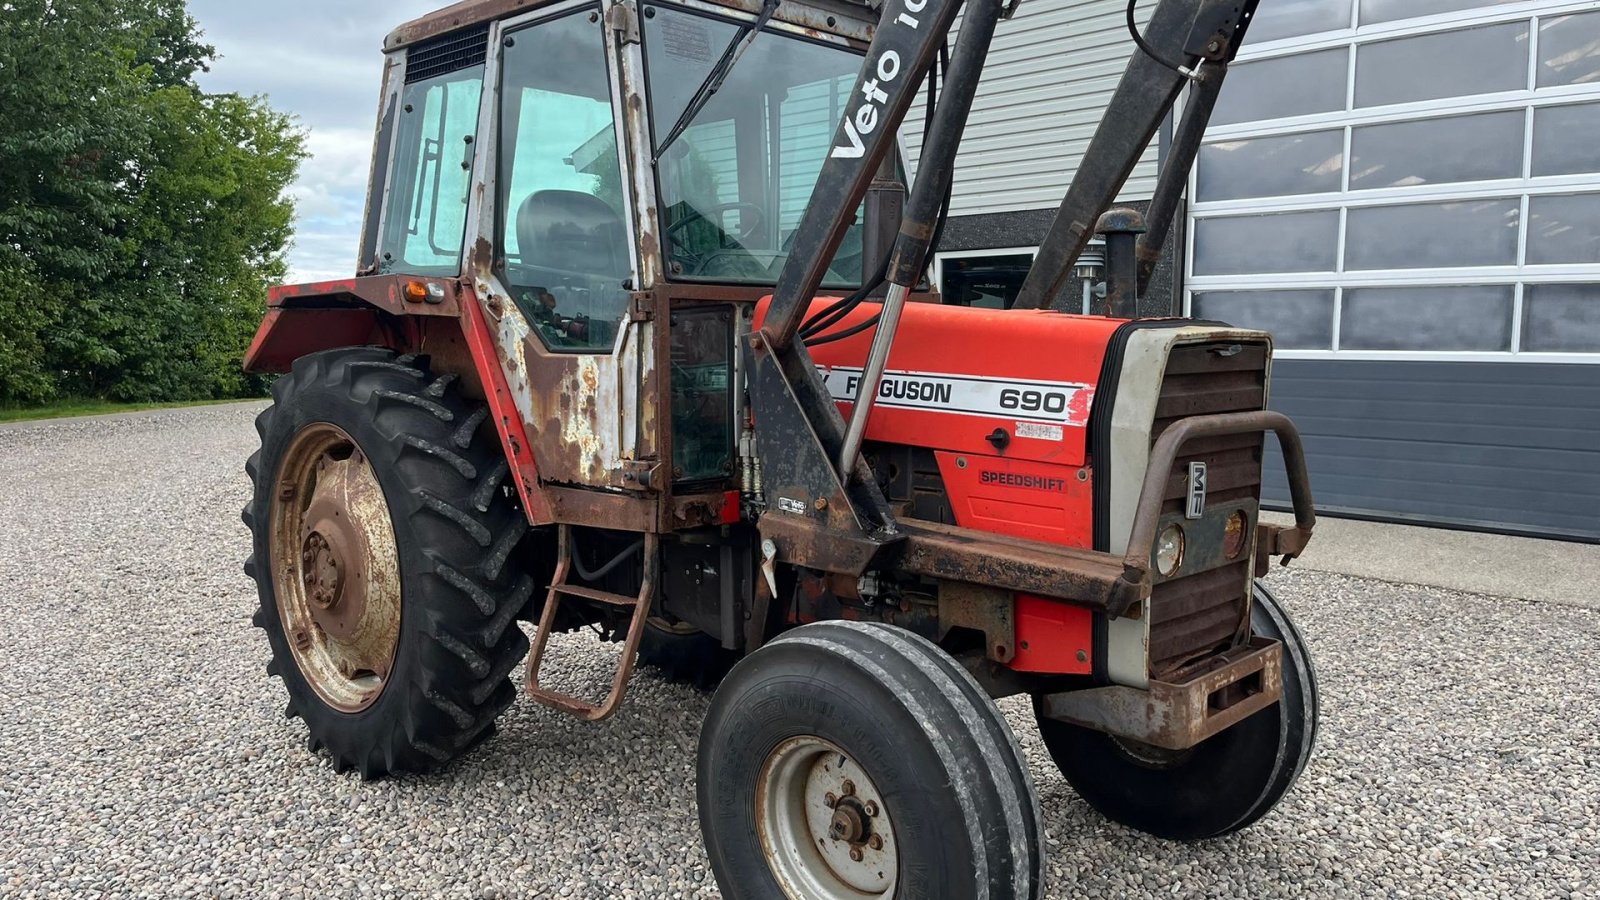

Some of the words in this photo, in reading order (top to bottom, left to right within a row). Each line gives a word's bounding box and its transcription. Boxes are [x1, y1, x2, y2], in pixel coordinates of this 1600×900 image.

[830, 50, 900, 158] Veto
[845, 376, 952, 403] FGUSON
[1000, 388, 1066, 414] 690
[981, 470, 1065, 492] SPEEDSHIFT
[1193, 466, 1205, 515] MF
